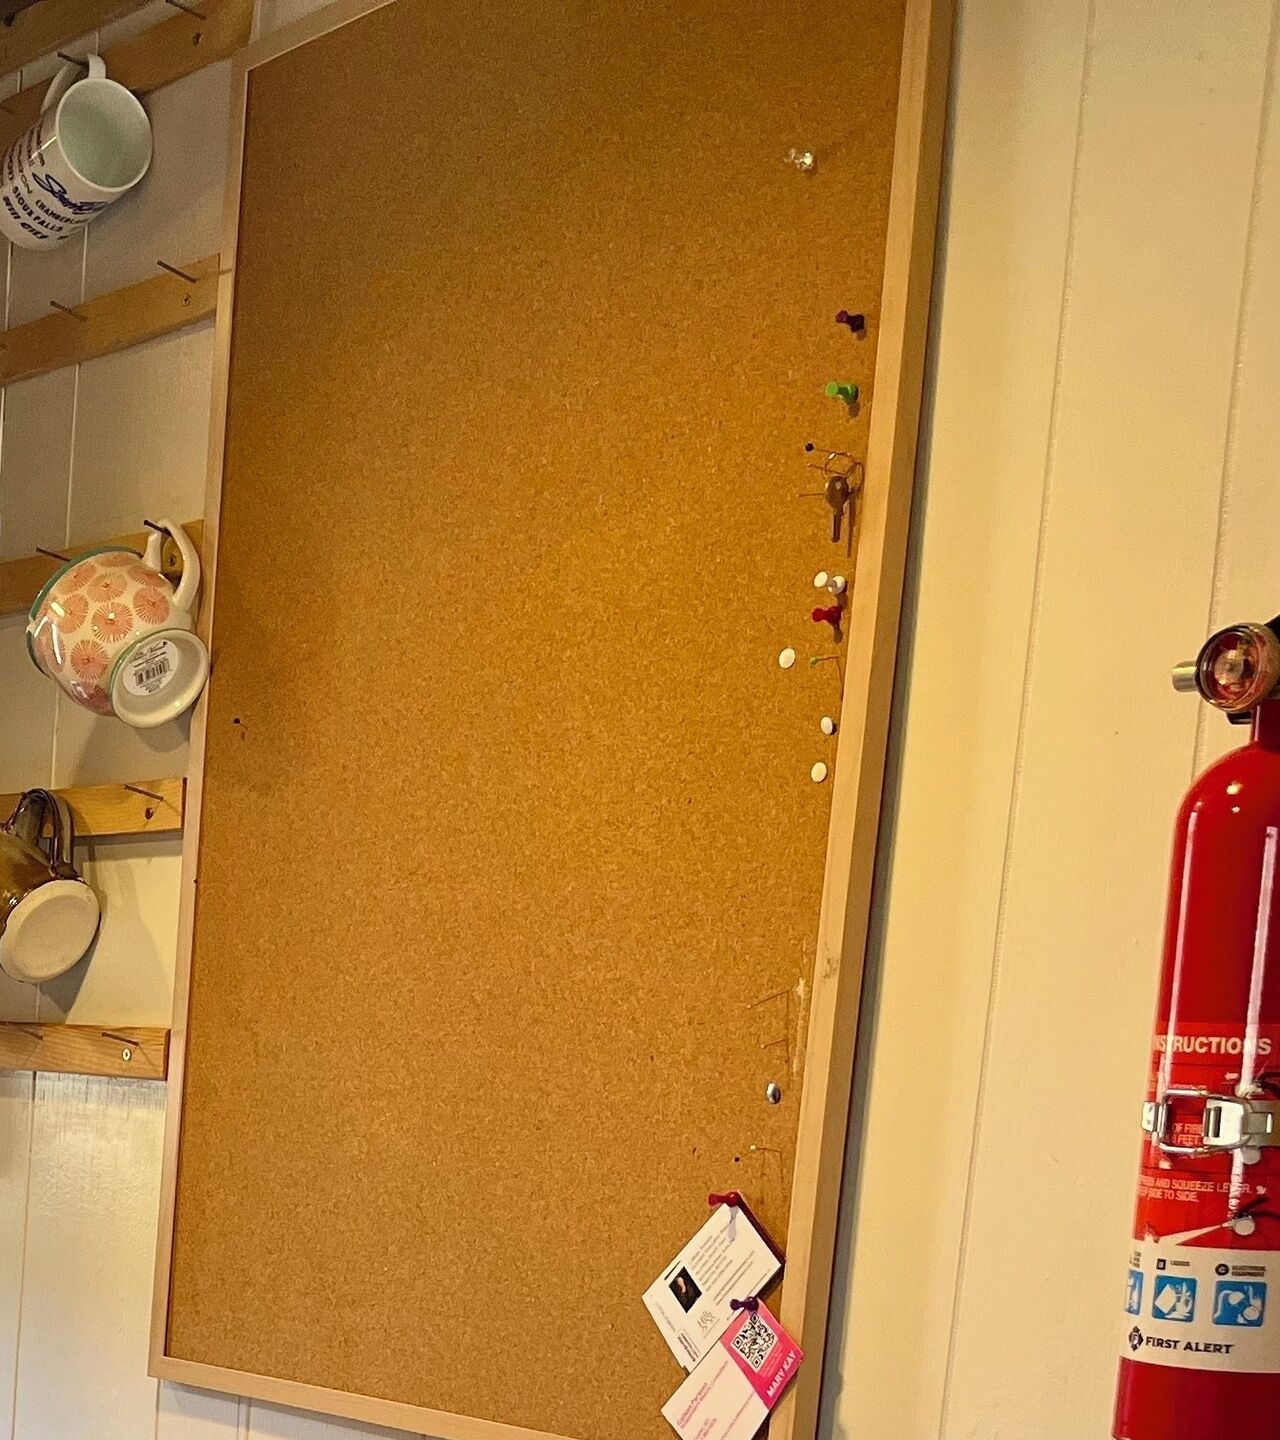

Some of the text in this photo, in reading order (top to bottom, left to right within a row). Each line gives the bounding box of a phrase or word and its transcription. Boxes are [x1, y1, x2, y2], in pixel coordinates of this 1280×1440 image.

[12, 186, 35, 218] SIOUX
[33, 216, 64, 233] FALLS
[1184, 1123, 1204, 1135] FIR
[1171, 1179, 1215, 1193] SQUEEZE
[1145, 1336, 1235, 1354] FIRST ALERT
[766, 1367, 786, 1398] MARY
[782, 1350, 796, 1371] KAY
